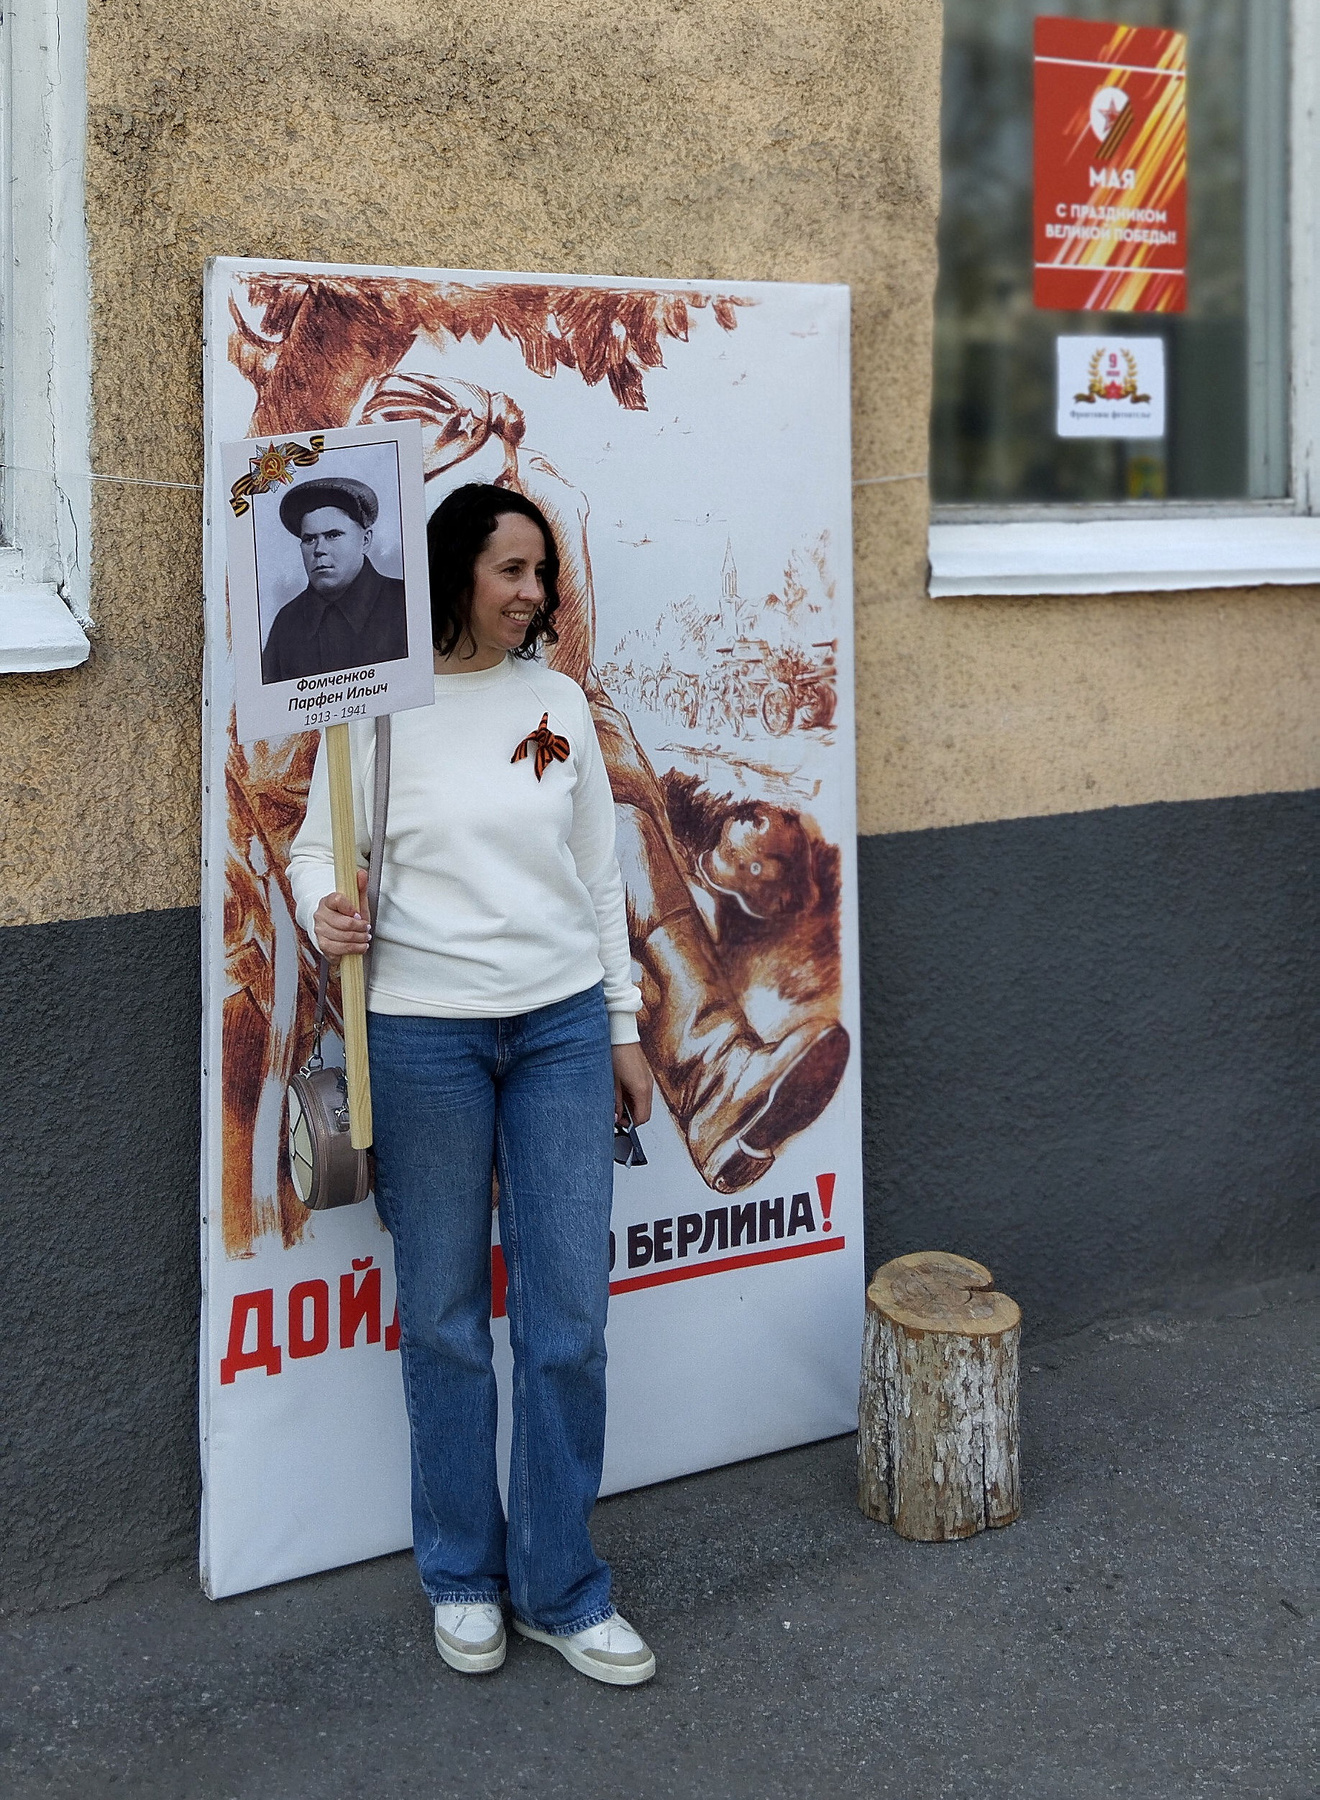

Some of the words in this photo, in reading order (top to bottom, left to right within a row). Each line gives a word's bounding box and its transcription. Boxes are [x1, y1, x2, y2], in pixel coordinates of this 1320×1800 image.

[1089, 166, 1135, 189] МАЯ
[1056, 203, 1067, 217] С
[1071, 204, 1167, 223] ПРАЗДНИКОМ
[1045, 223, 1112, 241] ВЕЛИКОЙ
[1114, 228, 1177, 245] ПОБЕДЫ!
[1109, 353, 1117, 368] 9
[297, 668, 375, 692] Фомченков
[288, 691, 343, 711] Парфен
[347, 682, 388, 700] Ильич
[304, 710, 331, 726] 1913
[341, 703, 367, 719] 1941
[220, 1245, 508, 1386] ДОЙ
[627, 1172, 836, 1269] БЕРЛИНА!
